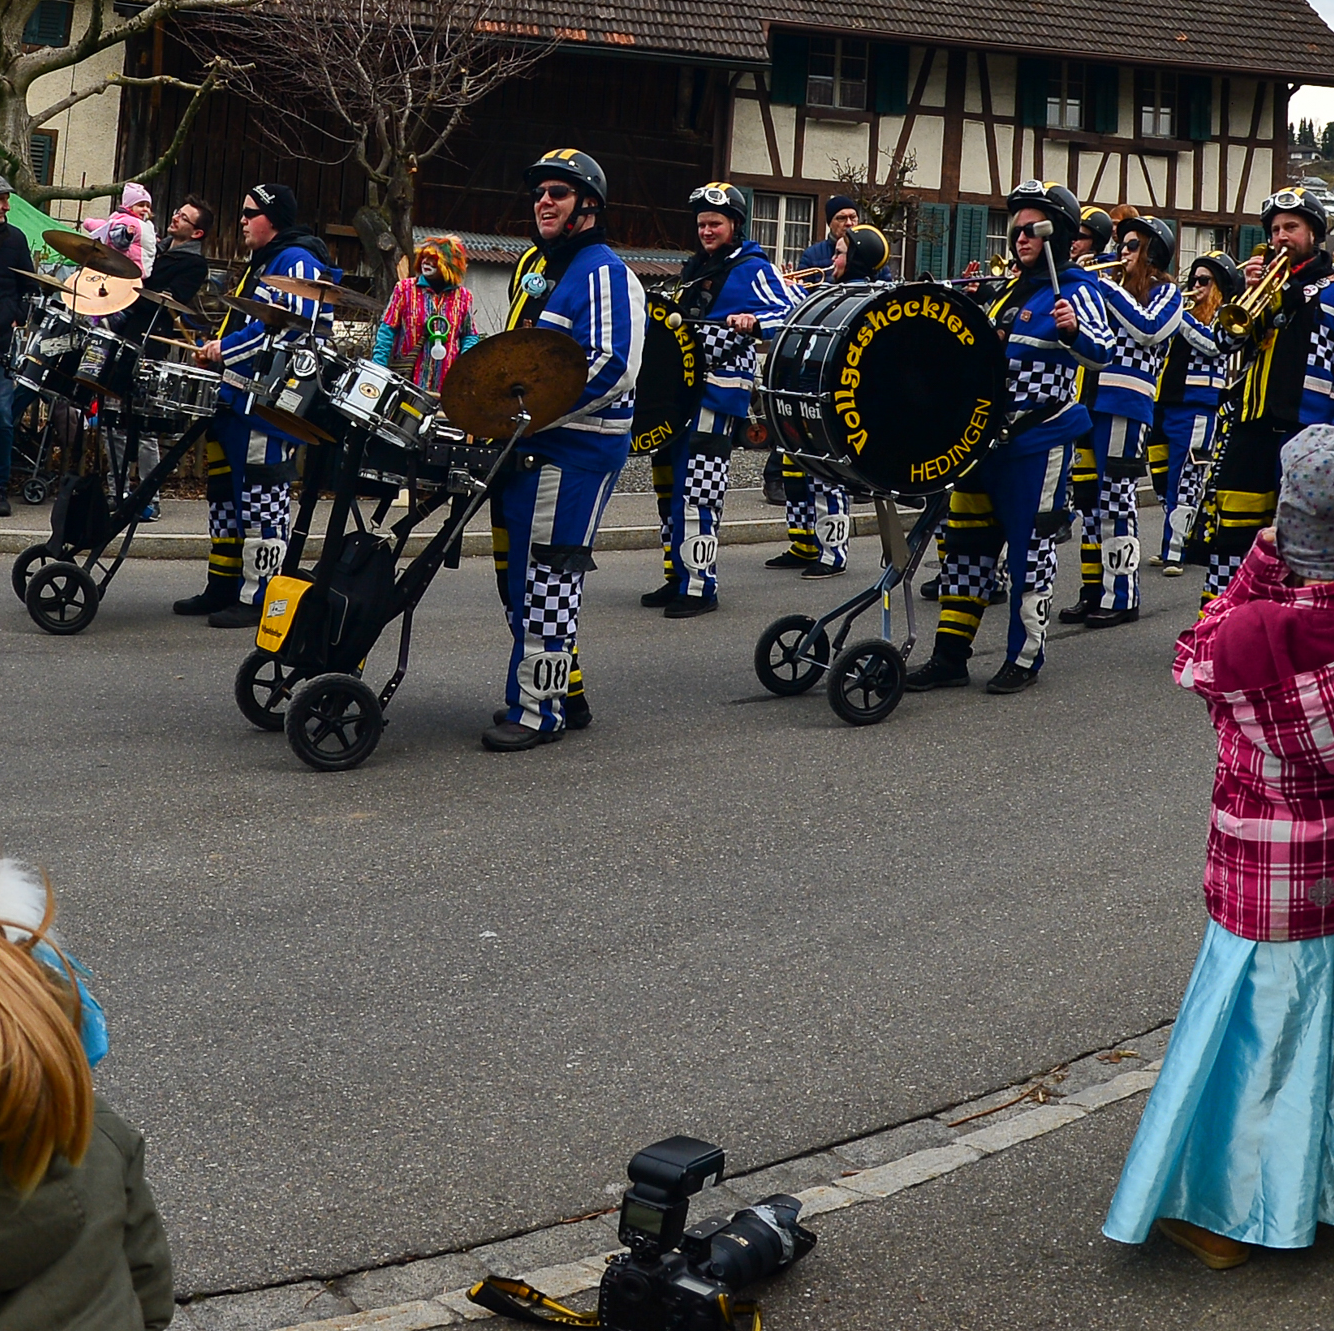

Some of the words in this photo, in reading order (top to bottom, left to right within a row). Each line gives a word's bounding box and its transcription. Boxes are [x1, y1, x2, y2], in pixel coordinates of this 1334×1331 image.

[834, 295, 975, 456] Vollgashöckler
[630, 420, 673, 452] NGEN
[911, 398, 993, 483] HEDINGEN
[825, 520, 845, 543] 28
[255, 546, 281, 571] 88
[693, 540, 715, 565] 00
[533, 658, 568, 692] 08
